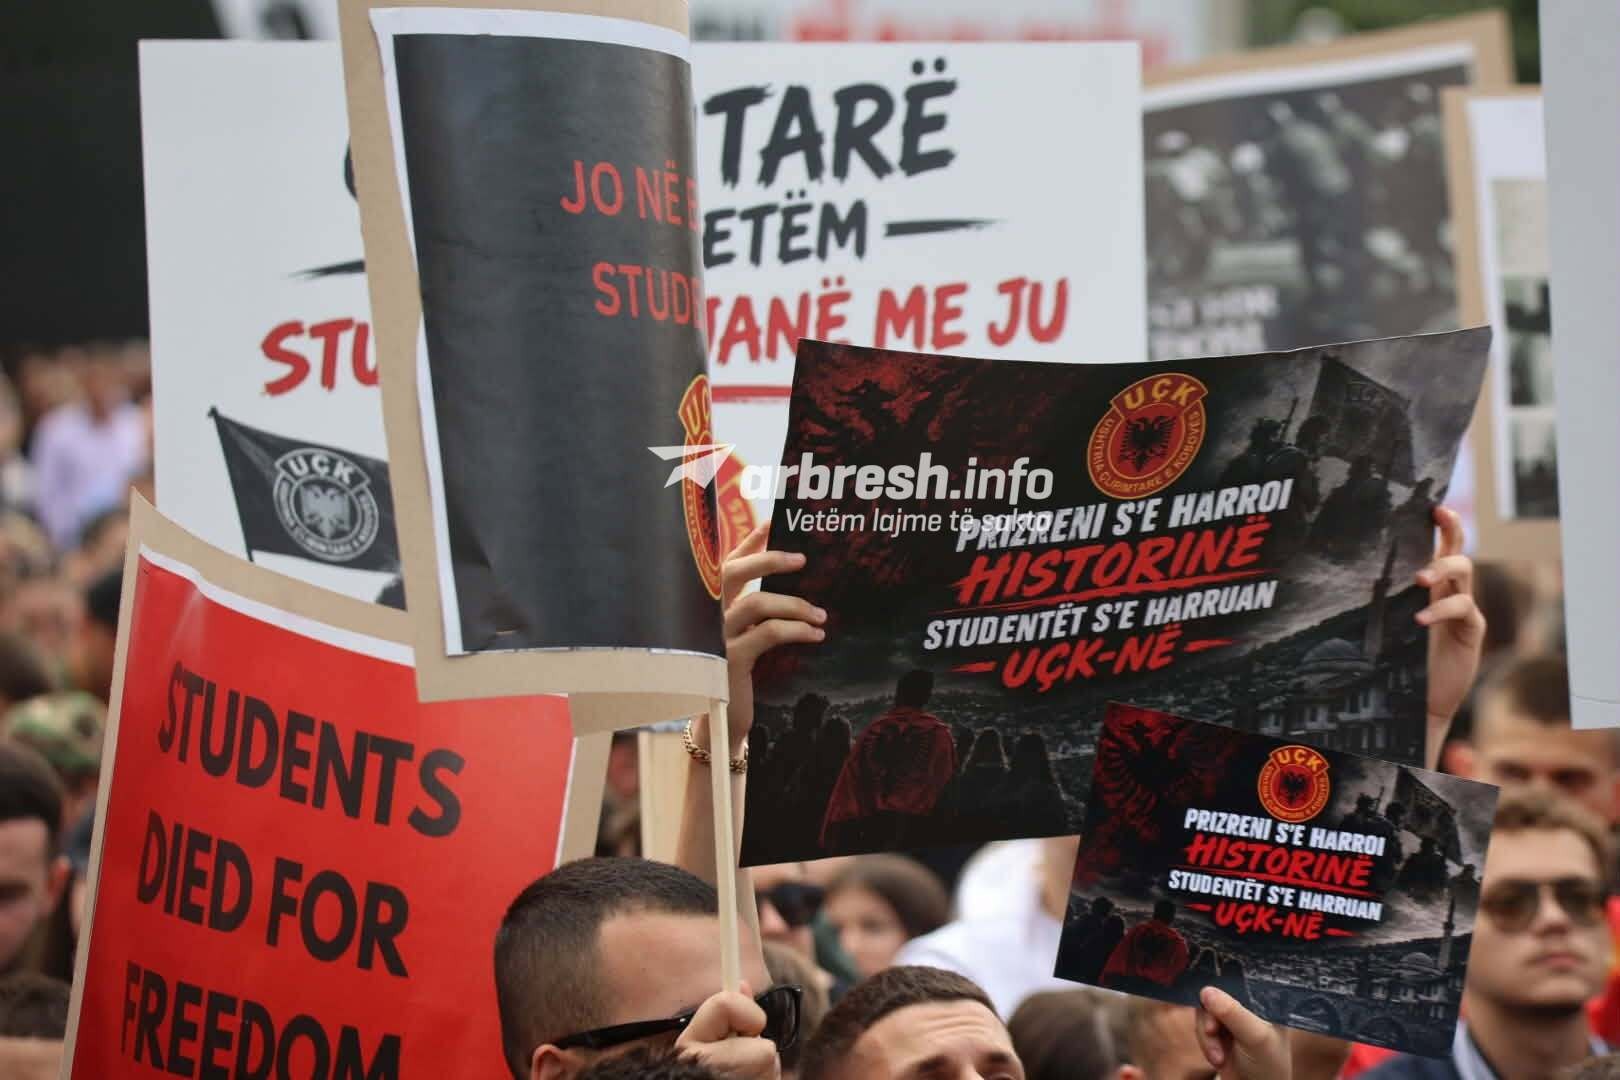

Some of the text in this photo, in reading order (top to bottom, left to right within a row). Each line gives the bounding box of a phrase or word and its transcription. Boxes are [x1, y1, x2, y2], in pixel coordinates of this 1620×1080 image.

[703, 57, 957, 188] TARË
[560, 160, 624, 216] JO
[635, 160, 682, 225] NË
[703, 190, 867, 269] ETËM
[874, 283, 969, 350] ME
[988, 277, 1068, 348] JU
[260, 317, 378, 396] STU
[956, 503, 1107, 552] PRIZRENI
[1168, 478, 1294, 528] HARROI
[955, 515, 1272, 606] HISTORINË
[923, 603, 1088, 650] STUDENTËT
[1144, 581, 1278, 626] HARRUAN
[1002, 624, 1183, 692] UÇK-NË
[158, 661, 465, 838] STUDENTS
[1184, 808, 1272, 840] PRIZRENI
[1310, 827, 1385, 856] HARROI
[1186, 834, 1374, 887] HISTORINË
[136, 810, 409, 977] DIED FOR
[1168, 869, 1264, 901] STUDENTËT
[1298, 891, 1384, 921] HARRUAN
[1215, 901, 1324, 940] UÇK-NË
[122, 961, 403, 1080] FREEDOM
